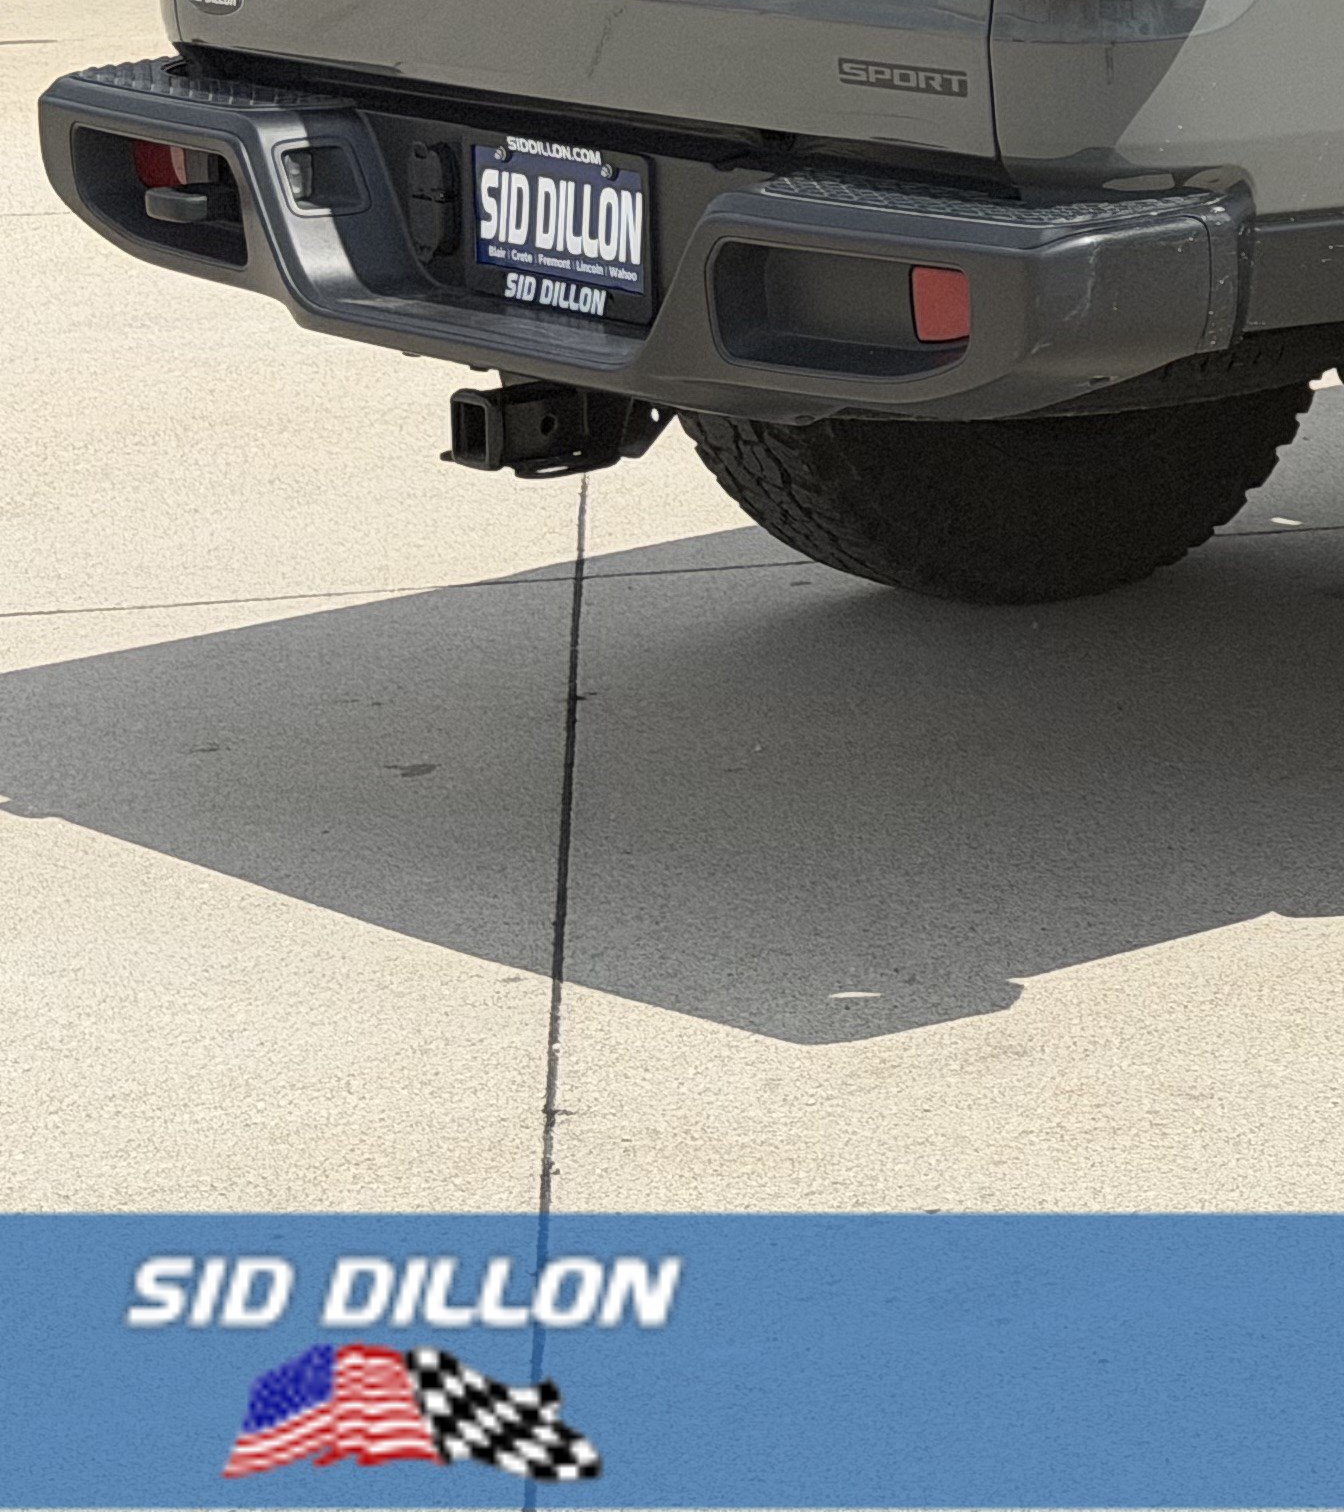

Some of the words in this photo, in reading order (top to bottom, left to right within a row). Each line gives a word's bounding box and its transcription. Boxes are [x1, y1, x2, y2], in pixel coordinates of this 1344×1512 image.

[839, 61, 969, 93] SPORT
[507, 136, 601, 165] SIDDILLON.COM
[480, 168, 531, 246] SID
[535, 177, 643, 265] DILLON
[504, 273, 537, 302] SID
[539, 279, 607, 316] DILLON
